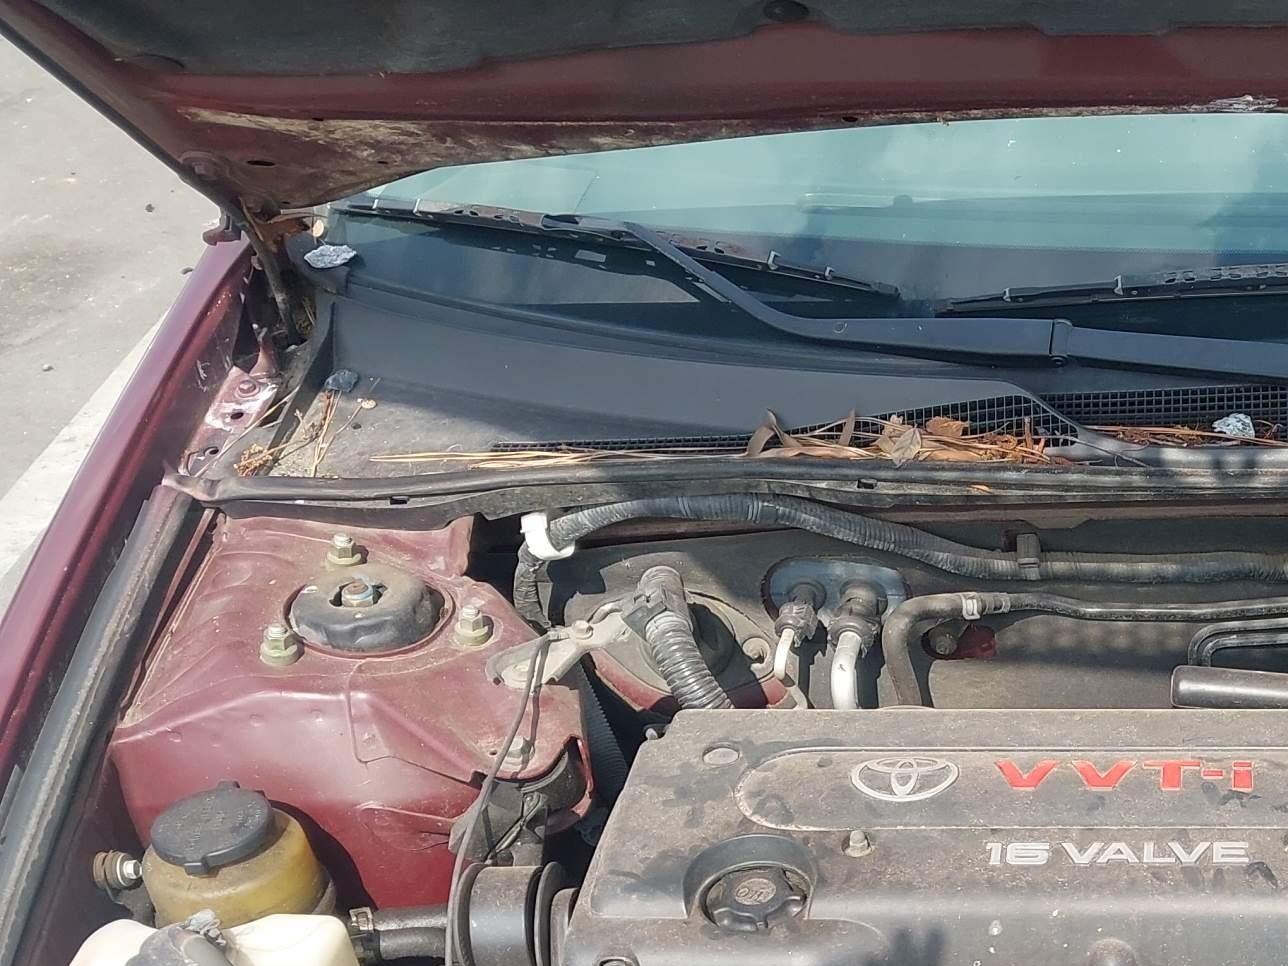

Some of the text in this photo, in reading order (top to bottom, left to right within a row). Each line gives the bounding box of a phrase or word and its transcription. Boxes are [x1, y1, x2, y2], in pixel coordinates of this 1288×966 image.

[994, 757, 1254, 791] VVT-i
[985, 841, 1250, 865] 16 VALVE
